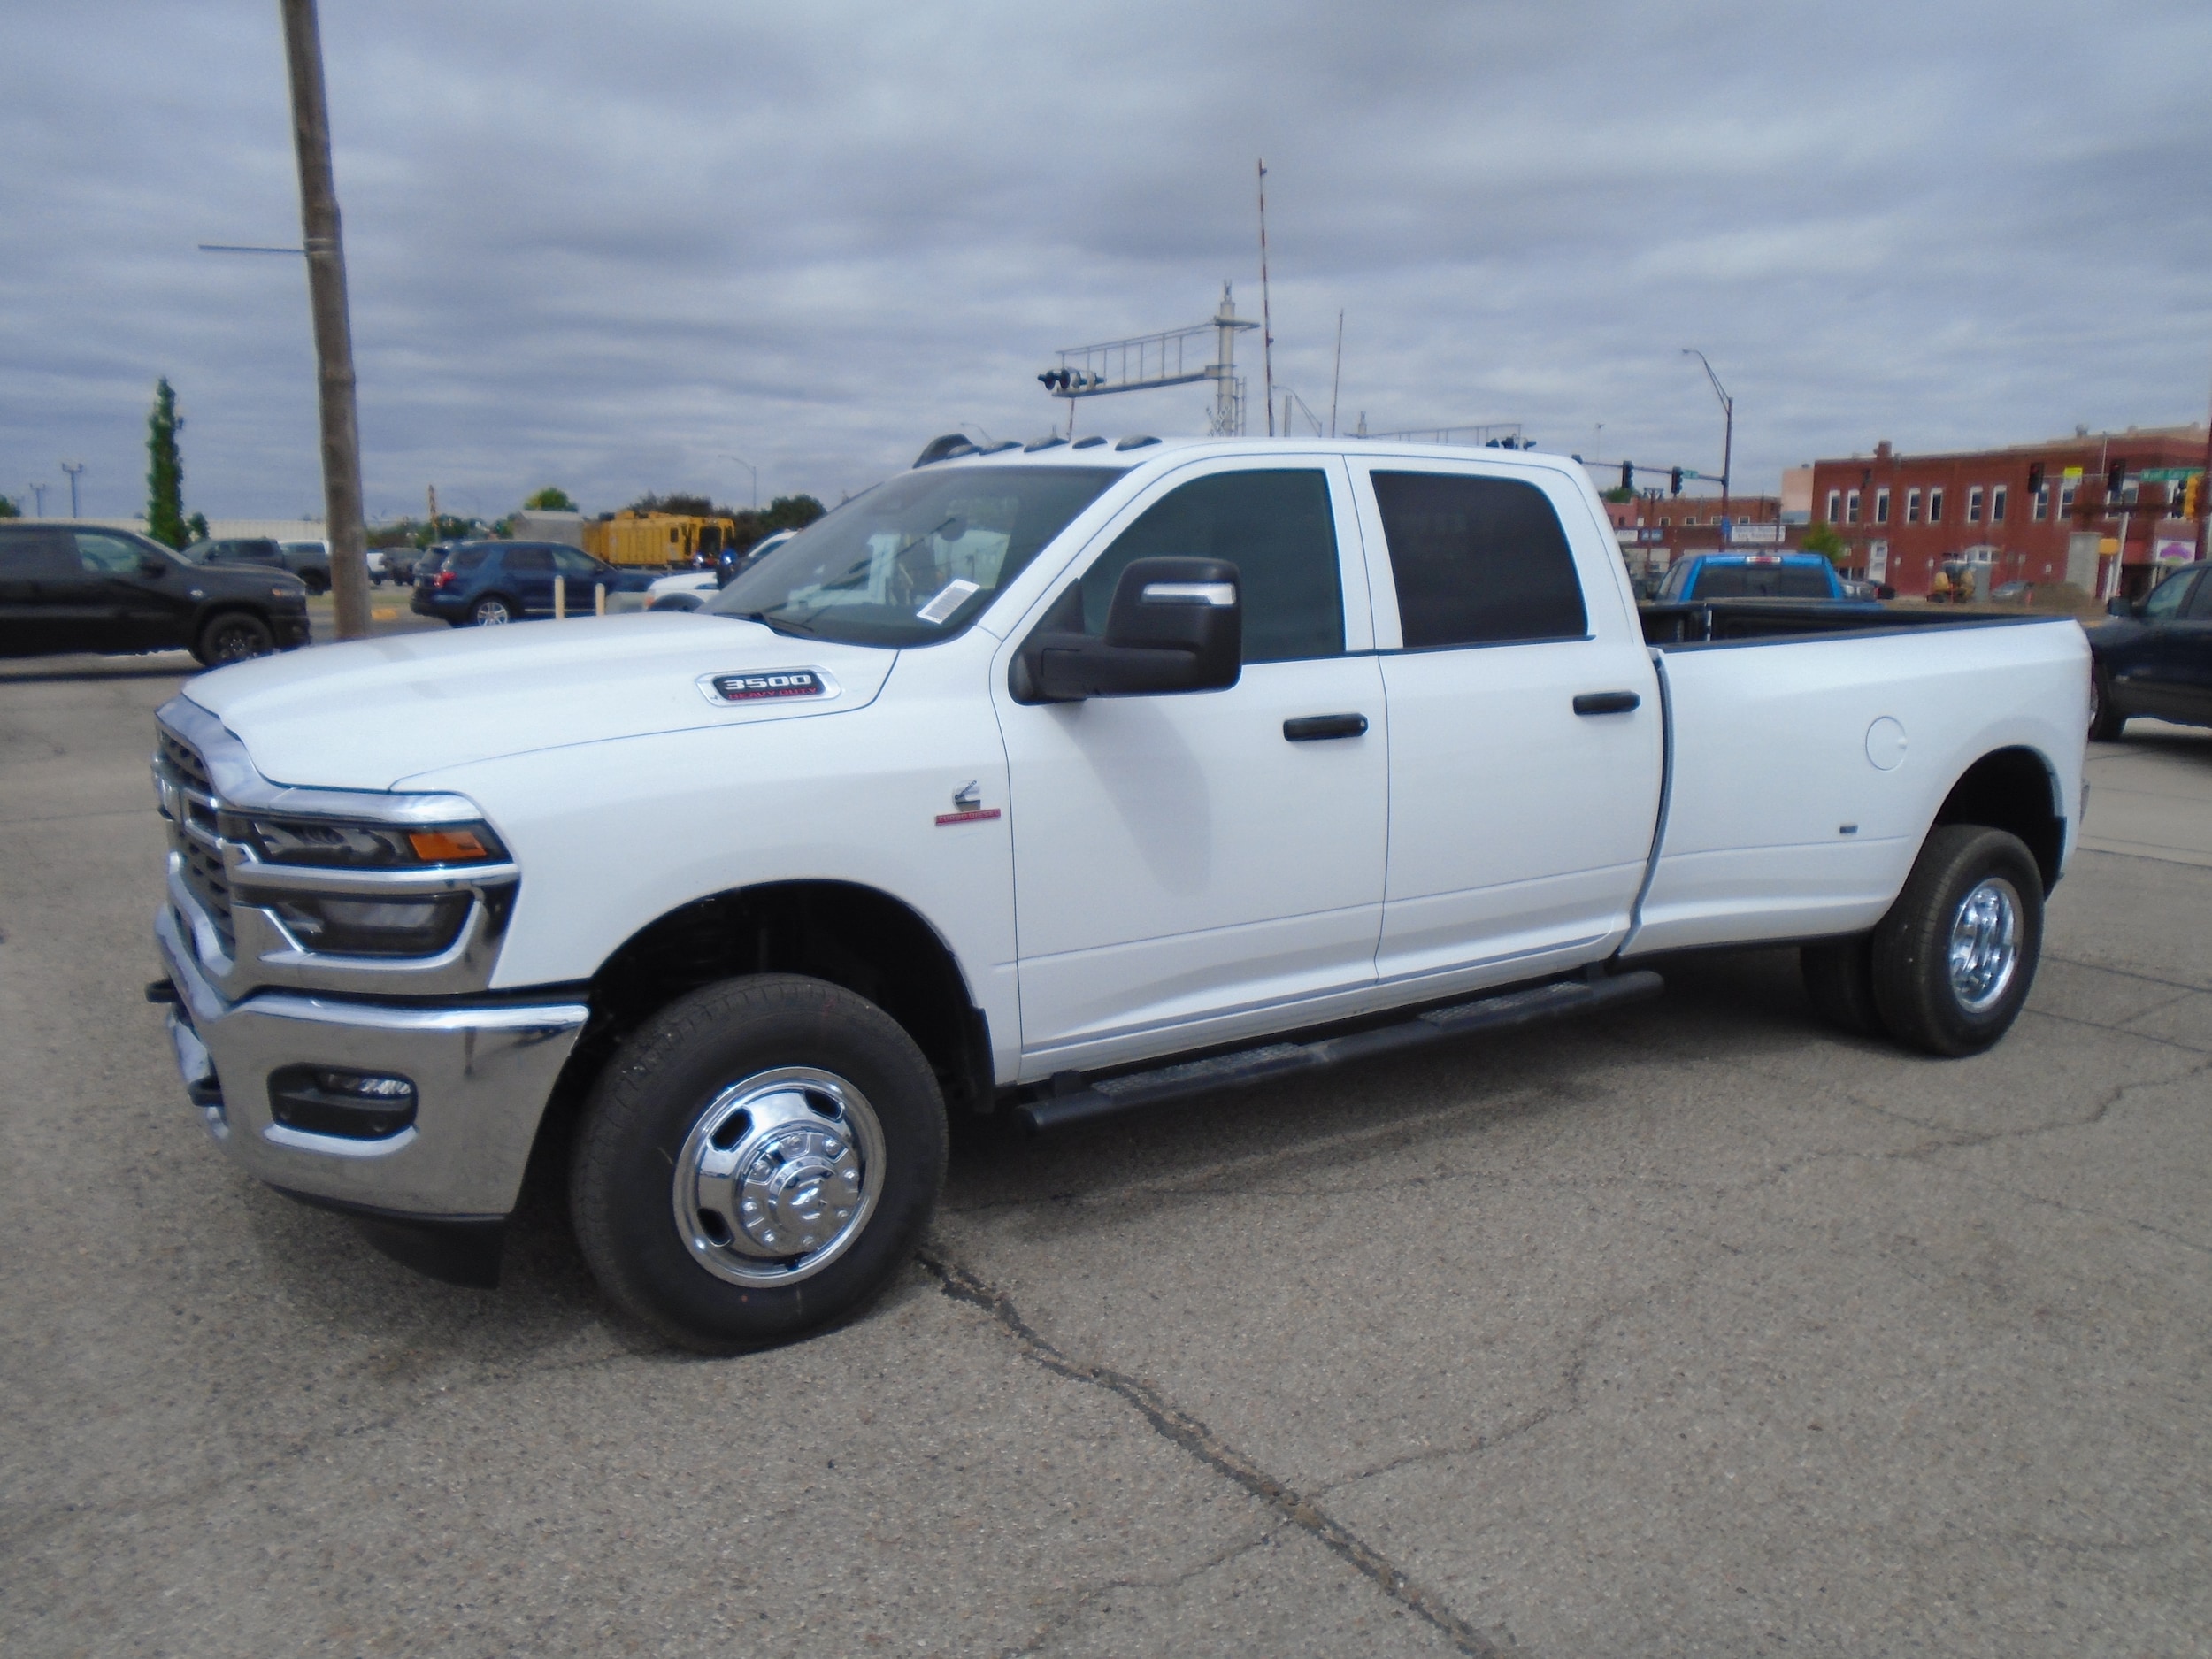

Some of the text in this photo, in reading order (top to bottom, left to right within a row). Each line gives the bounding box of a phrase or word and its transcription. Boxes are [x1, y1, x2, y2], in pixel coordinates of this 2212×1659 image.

[723, 673, 812, 691] 3500
[728, 687, 817, 701] HEAVY DUTY
